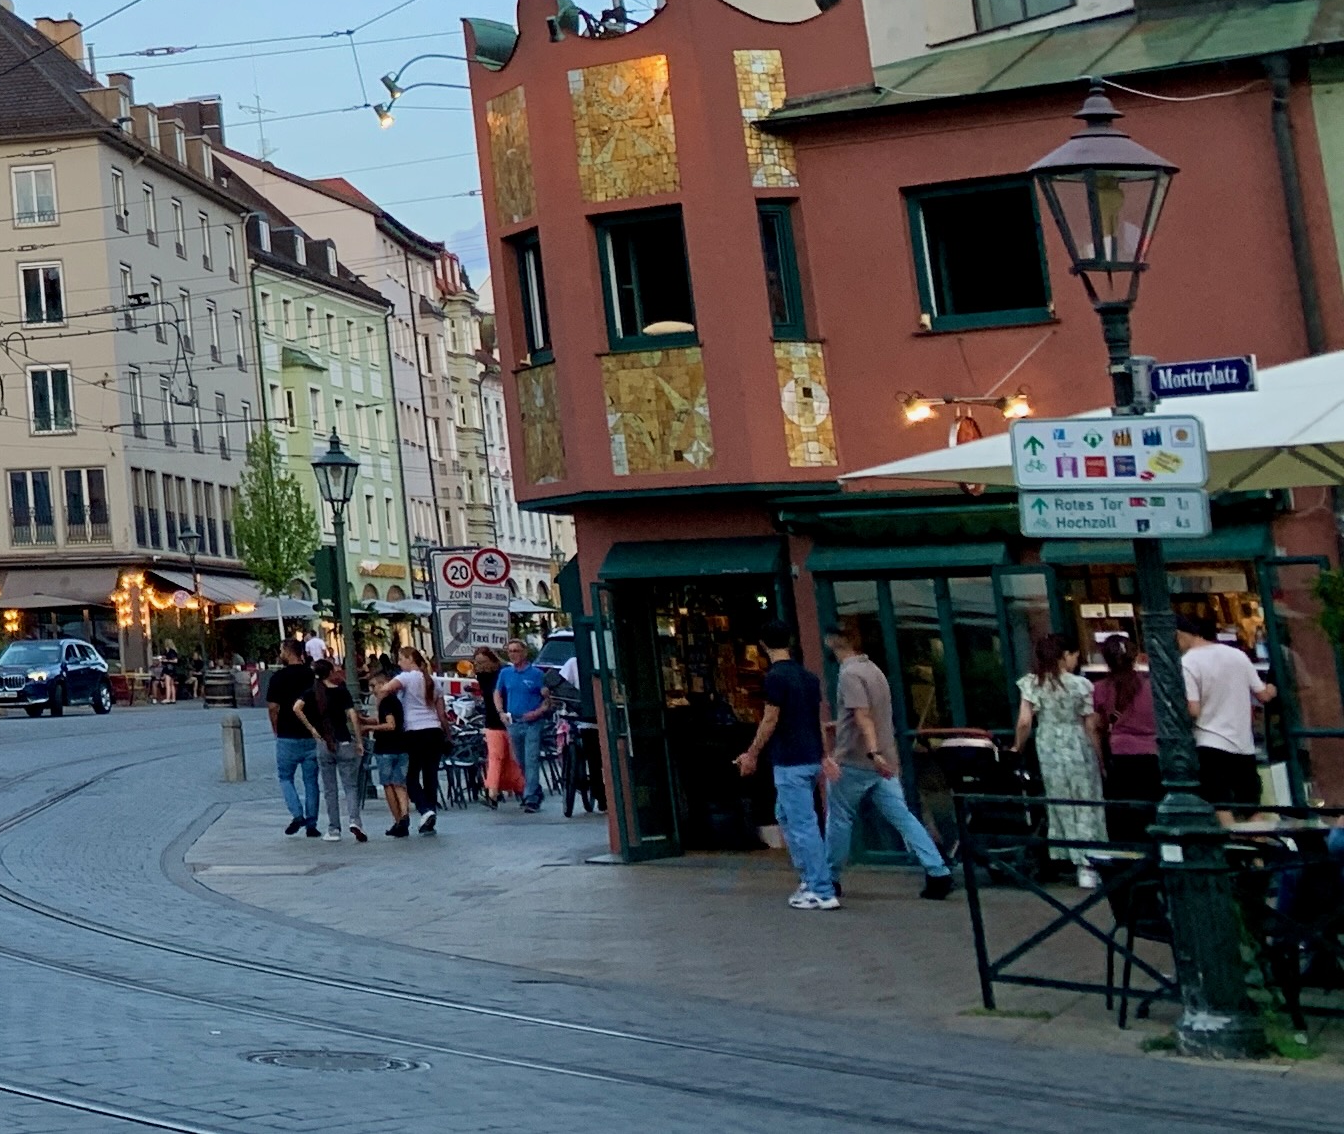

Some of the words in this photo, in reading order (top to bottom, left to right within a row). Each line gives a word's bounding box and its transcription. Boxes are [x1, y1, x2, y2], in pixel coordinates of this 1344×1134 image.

[1055, 498, 1094, 511] Rotes
[1100, 497, 1123, 511] Tor
[1056, 517, 1116, 529] Hochzoll
[450, 565, 468, 580] 20
[472, 632, 489, 643] Taxi
[492, 633, 507, 646] frei
